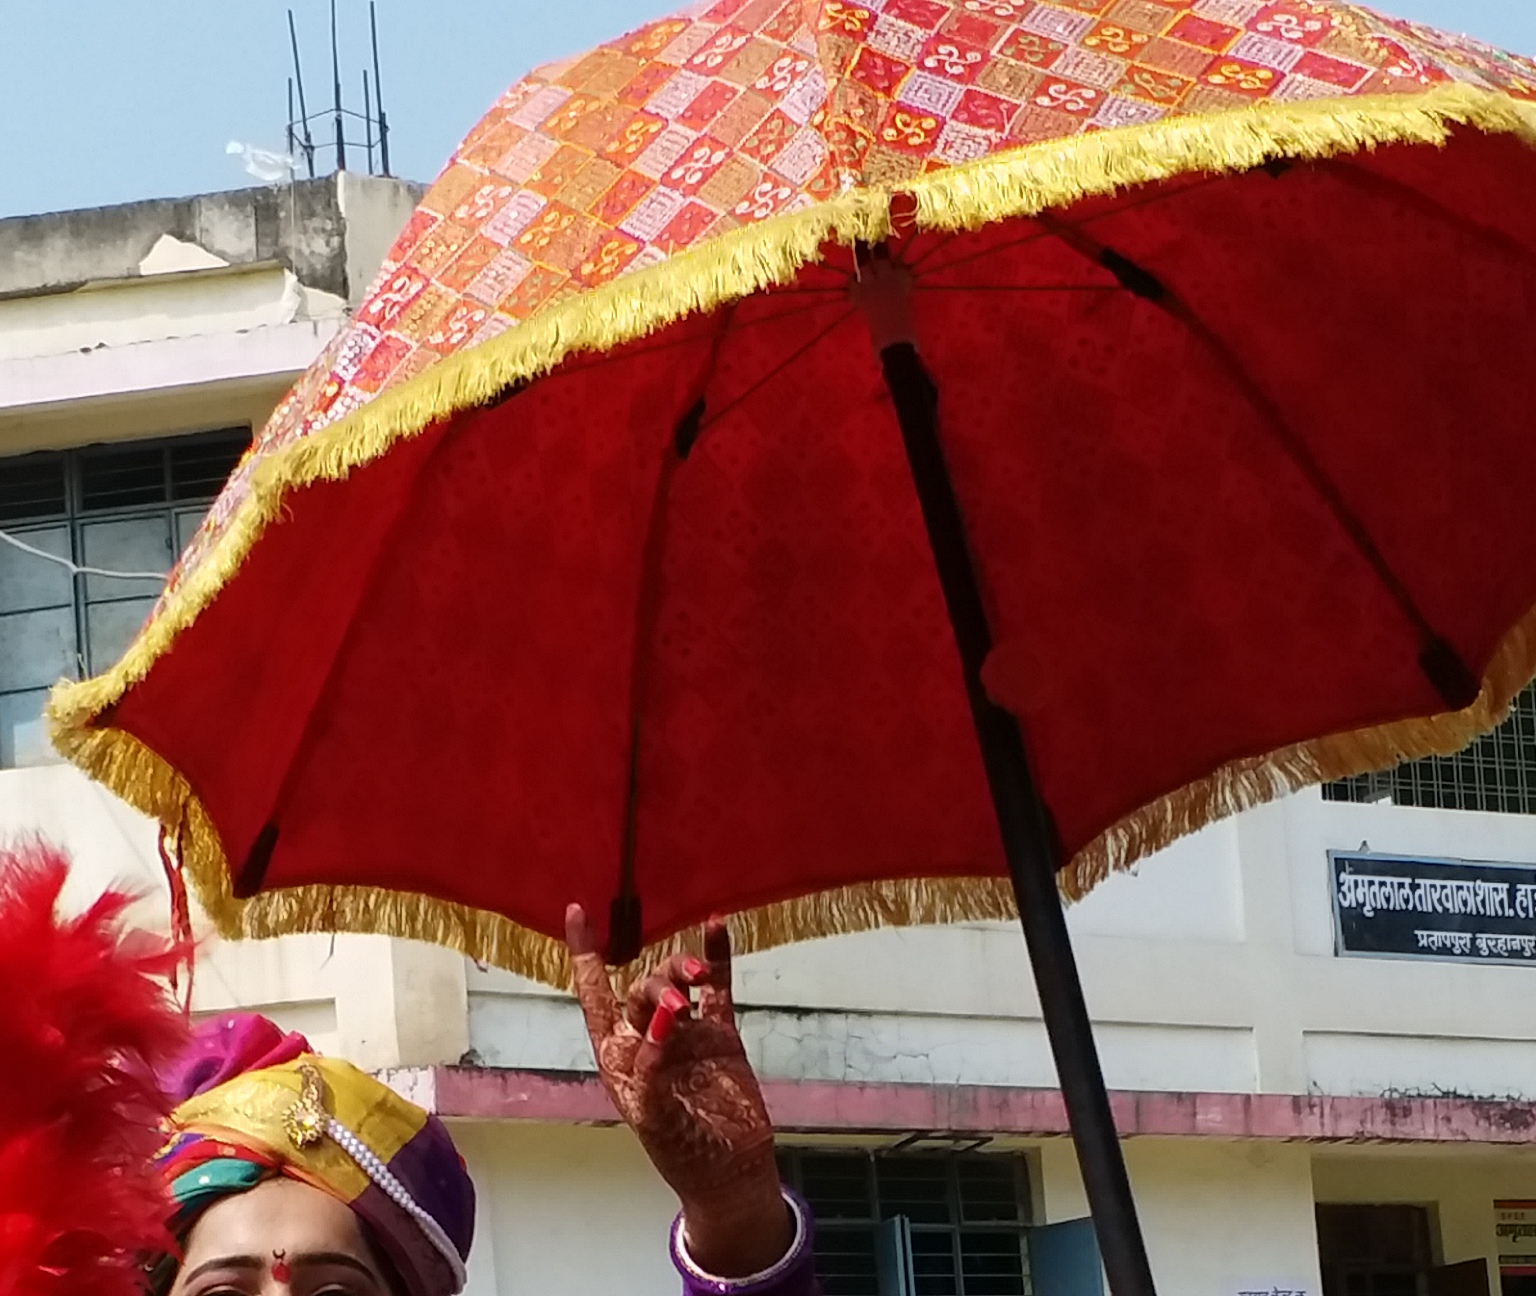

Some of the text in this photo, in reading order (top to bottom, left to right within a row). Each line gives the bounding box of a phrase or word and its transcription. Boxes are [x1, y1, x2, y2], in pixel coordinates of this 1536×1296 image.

[1338, 872, 1413, 917] अमृतलाल
[1414, 877, 1476, 915] तारवाला
[1414, 930, 1536, 957] प्रतापपुरा बुरहानपुर
